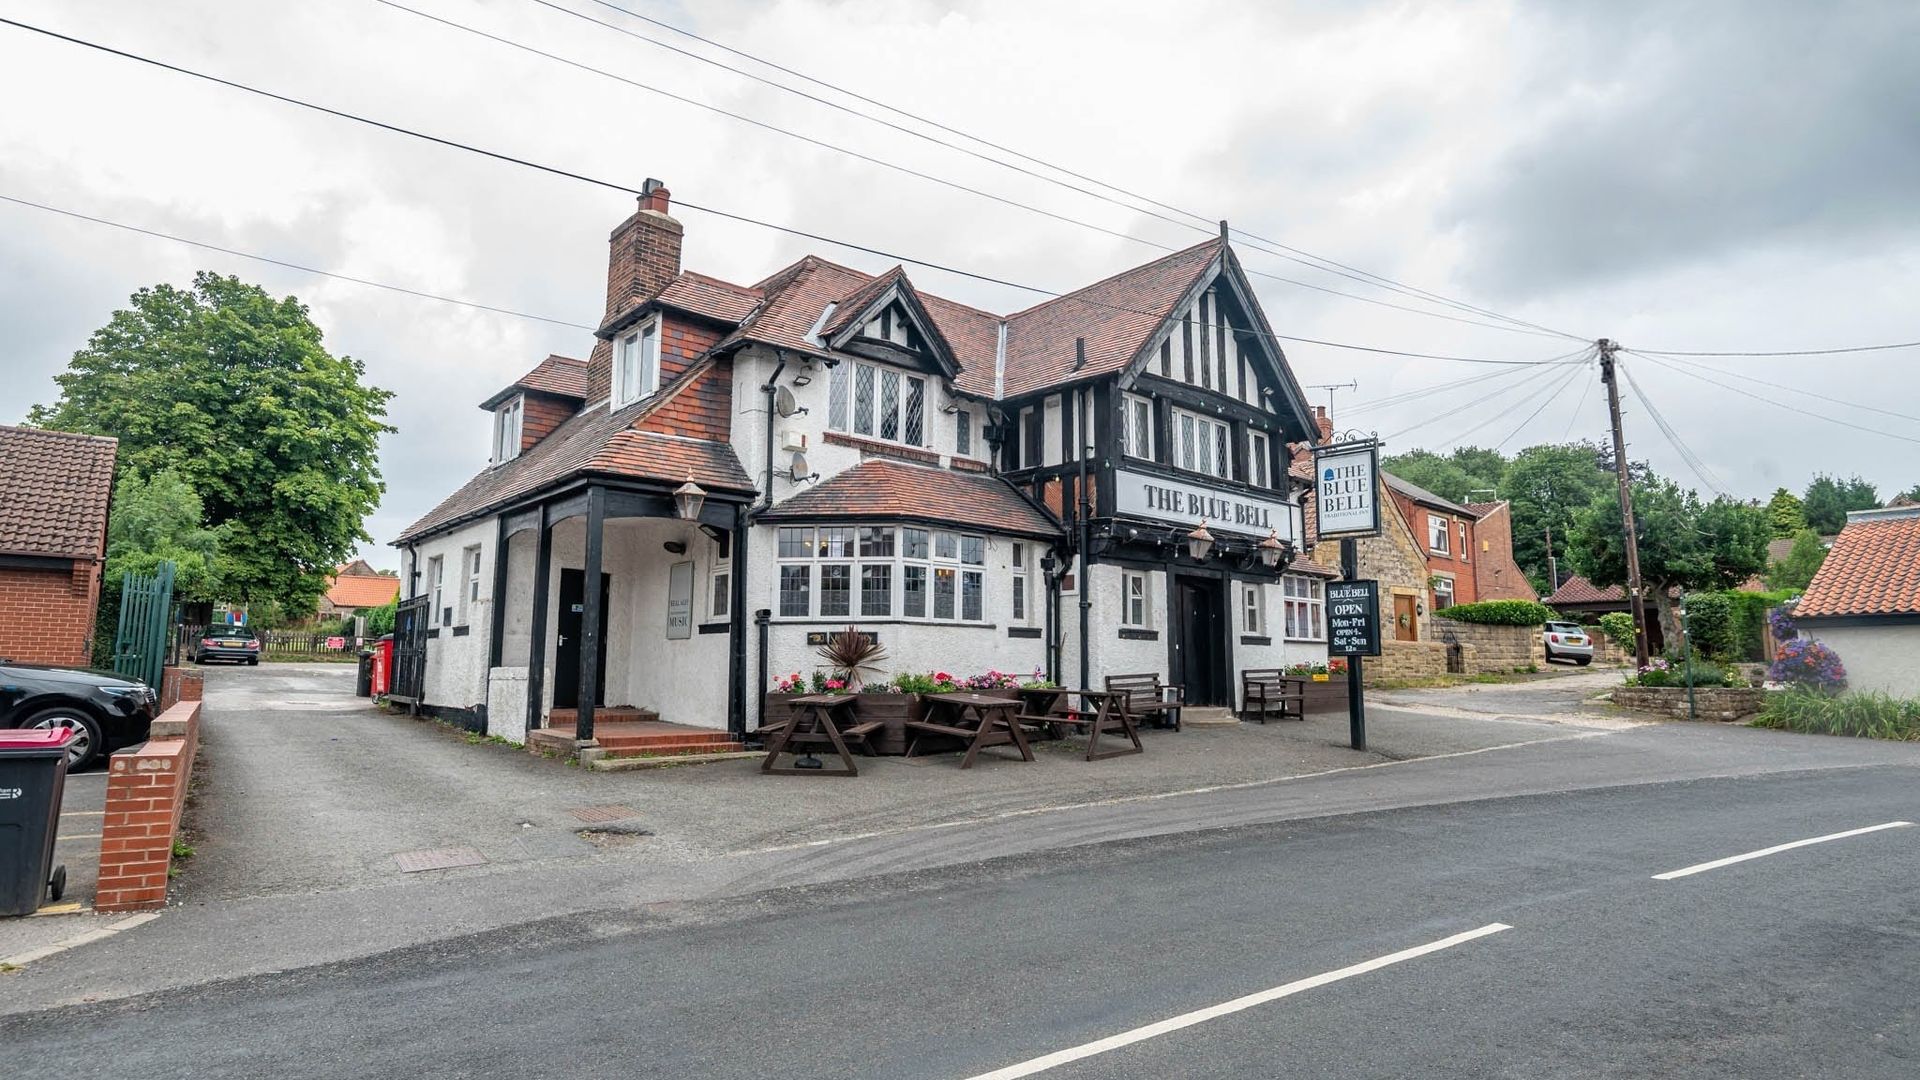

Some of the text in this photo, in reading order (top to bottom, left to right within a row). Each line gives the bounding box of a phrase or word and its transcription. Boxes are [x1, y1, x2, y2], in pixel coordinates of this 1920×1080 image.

[1334, 464, 1366, 479] THE
[1323, 478, 1368, 496] BLUE
[1144, 484, 1273, 529] THE BLUE BELL
[1324, 494, 1369, 512] BELL
[1330, 588, 1370, 598] BLUE BELL
[1334, 604, 1363, 615] OPEN
